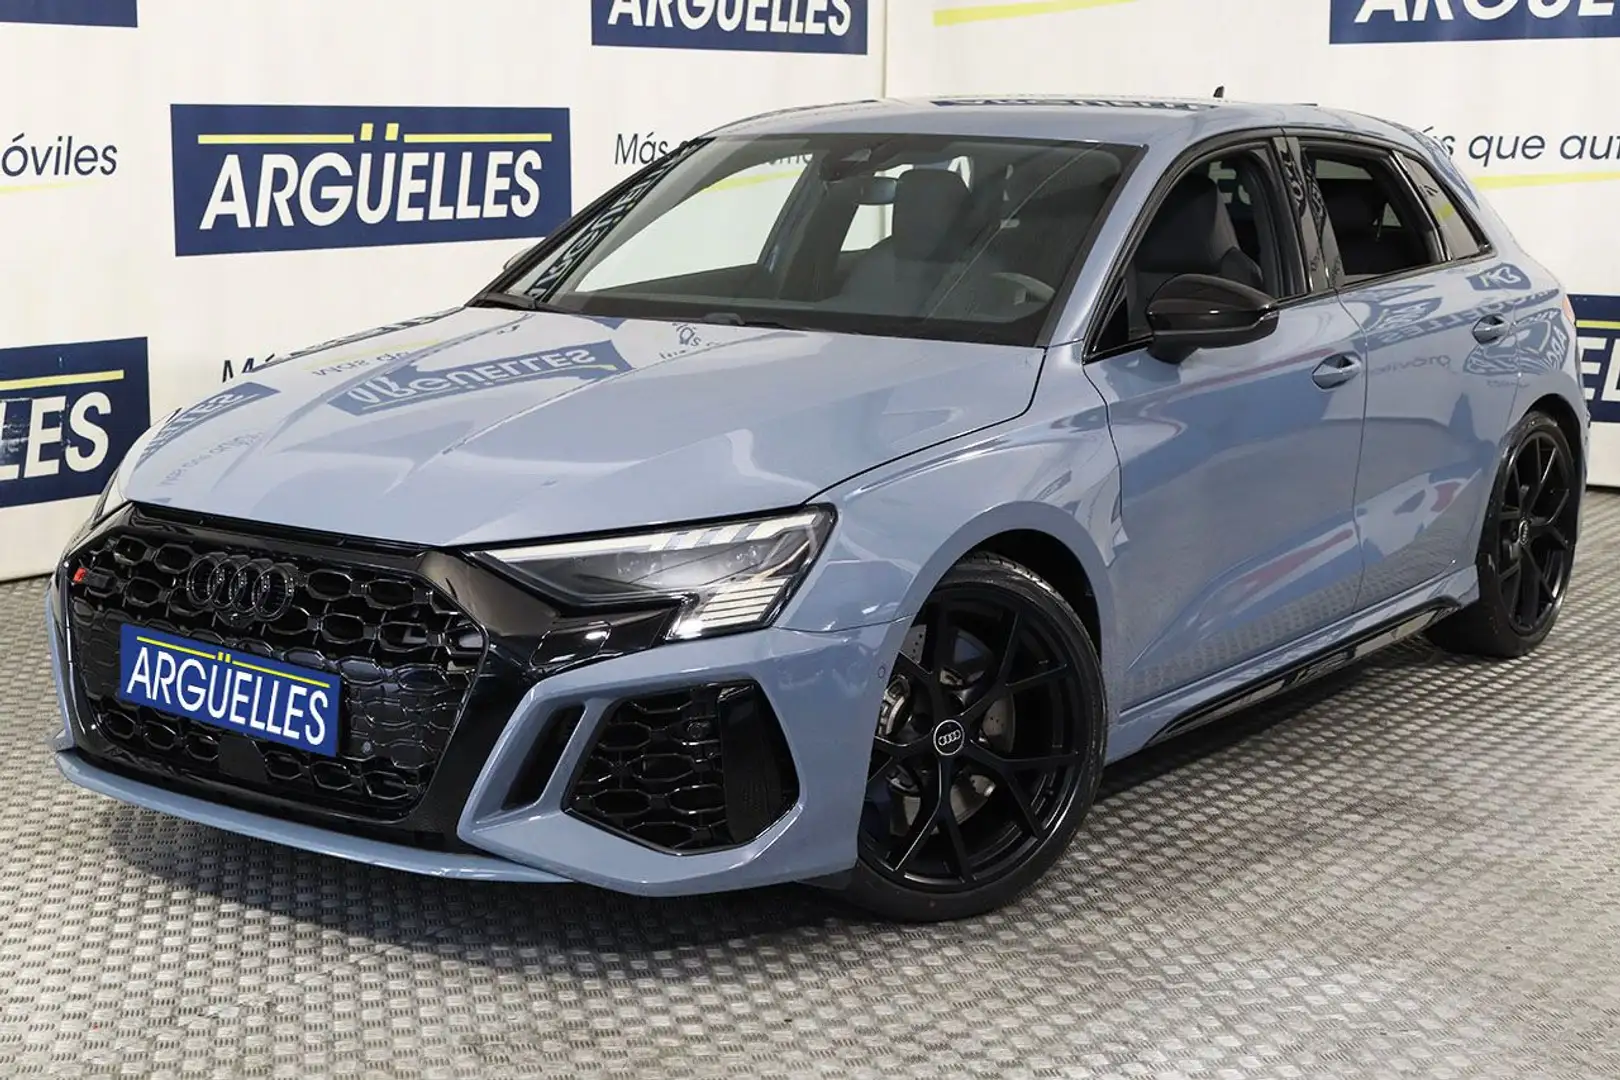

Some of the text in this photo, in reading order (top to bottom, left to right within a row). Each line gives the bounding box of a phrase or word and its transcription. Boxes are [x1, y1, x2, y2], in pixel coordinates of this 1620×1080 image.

[1, 132, 118, 177] óviles
[199, 123, 543, 230] ARGÜELLES
[1468, 134, 1546, 167] que
[127, 646, 329, 746] ARGÜELLES
